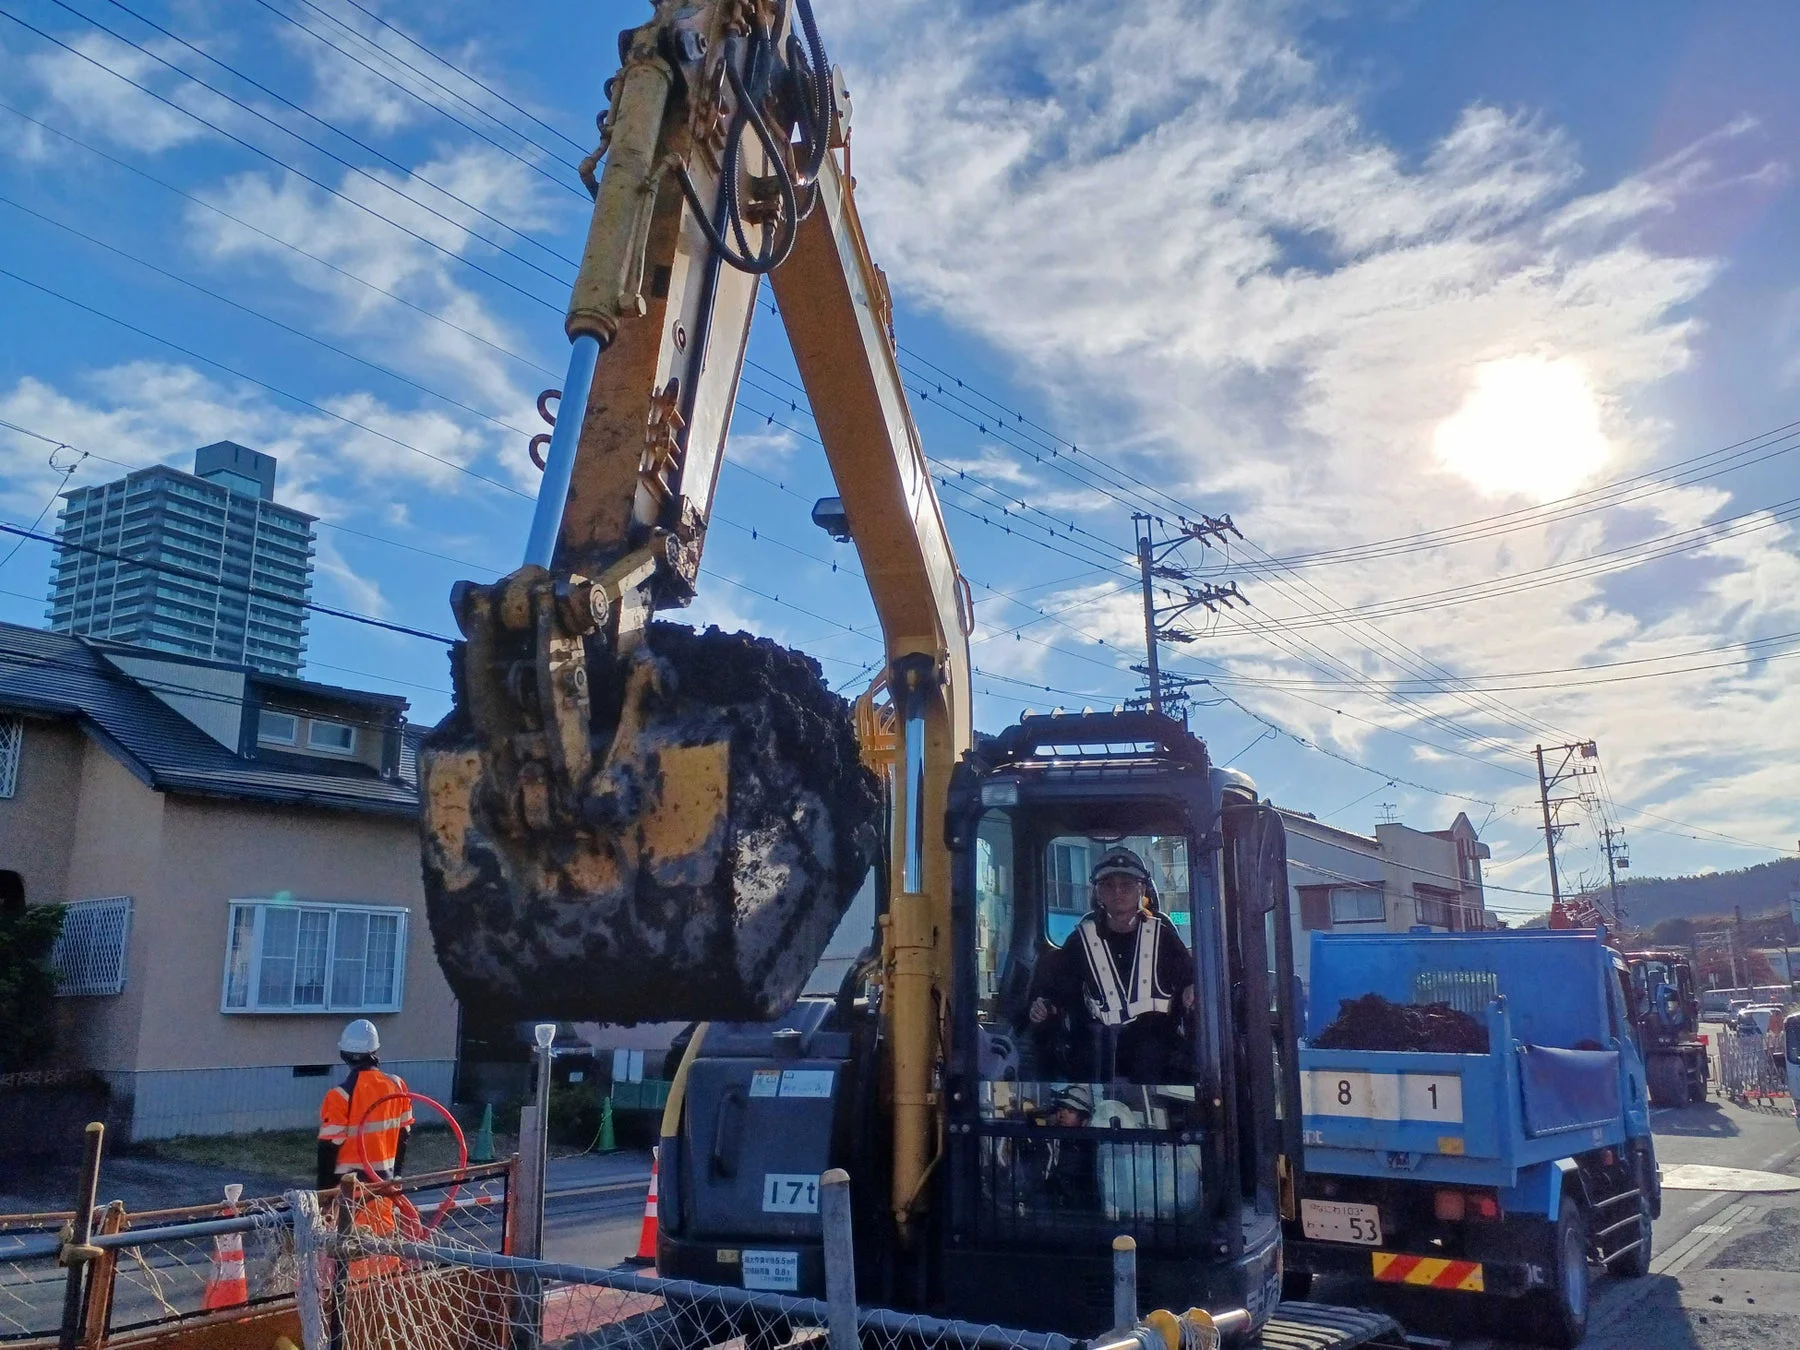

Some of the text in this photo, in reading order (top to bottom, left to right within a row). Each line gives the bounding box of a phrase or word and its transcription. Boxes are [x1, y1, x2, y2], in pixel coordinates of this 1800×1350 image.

[1337, 1079, 1438, 1110] 8 1
[771, 1181, 816, 1205] 1.7t
